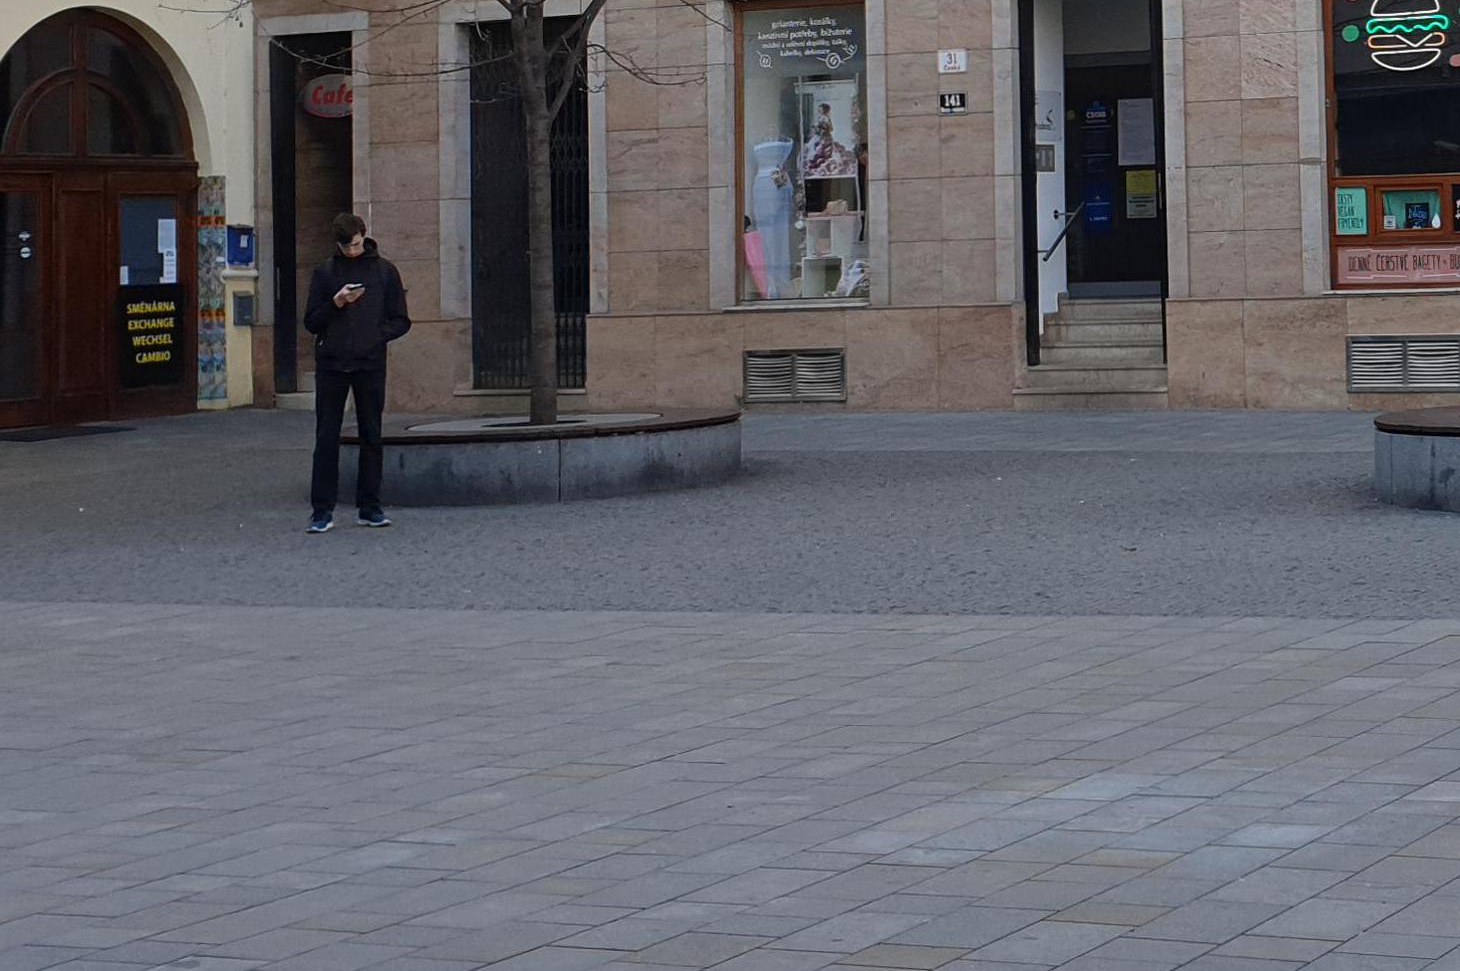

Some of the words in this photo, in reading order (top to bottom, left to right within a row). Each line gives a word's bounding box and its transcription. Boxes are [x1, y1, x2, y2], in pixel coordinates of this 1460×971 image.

[946, 52, 957, 65] 31
[944, 94, 961, 107] 141
[1412, 254, 1440, 270] BAGETY
[127, 300, 176, 314] SMĚNÁRNA
[127, 316, 175, 330] EXCHANGE
[132, 333, 173, 346] WECHSEL
[135, 350, 171, 364] CAMBIO
